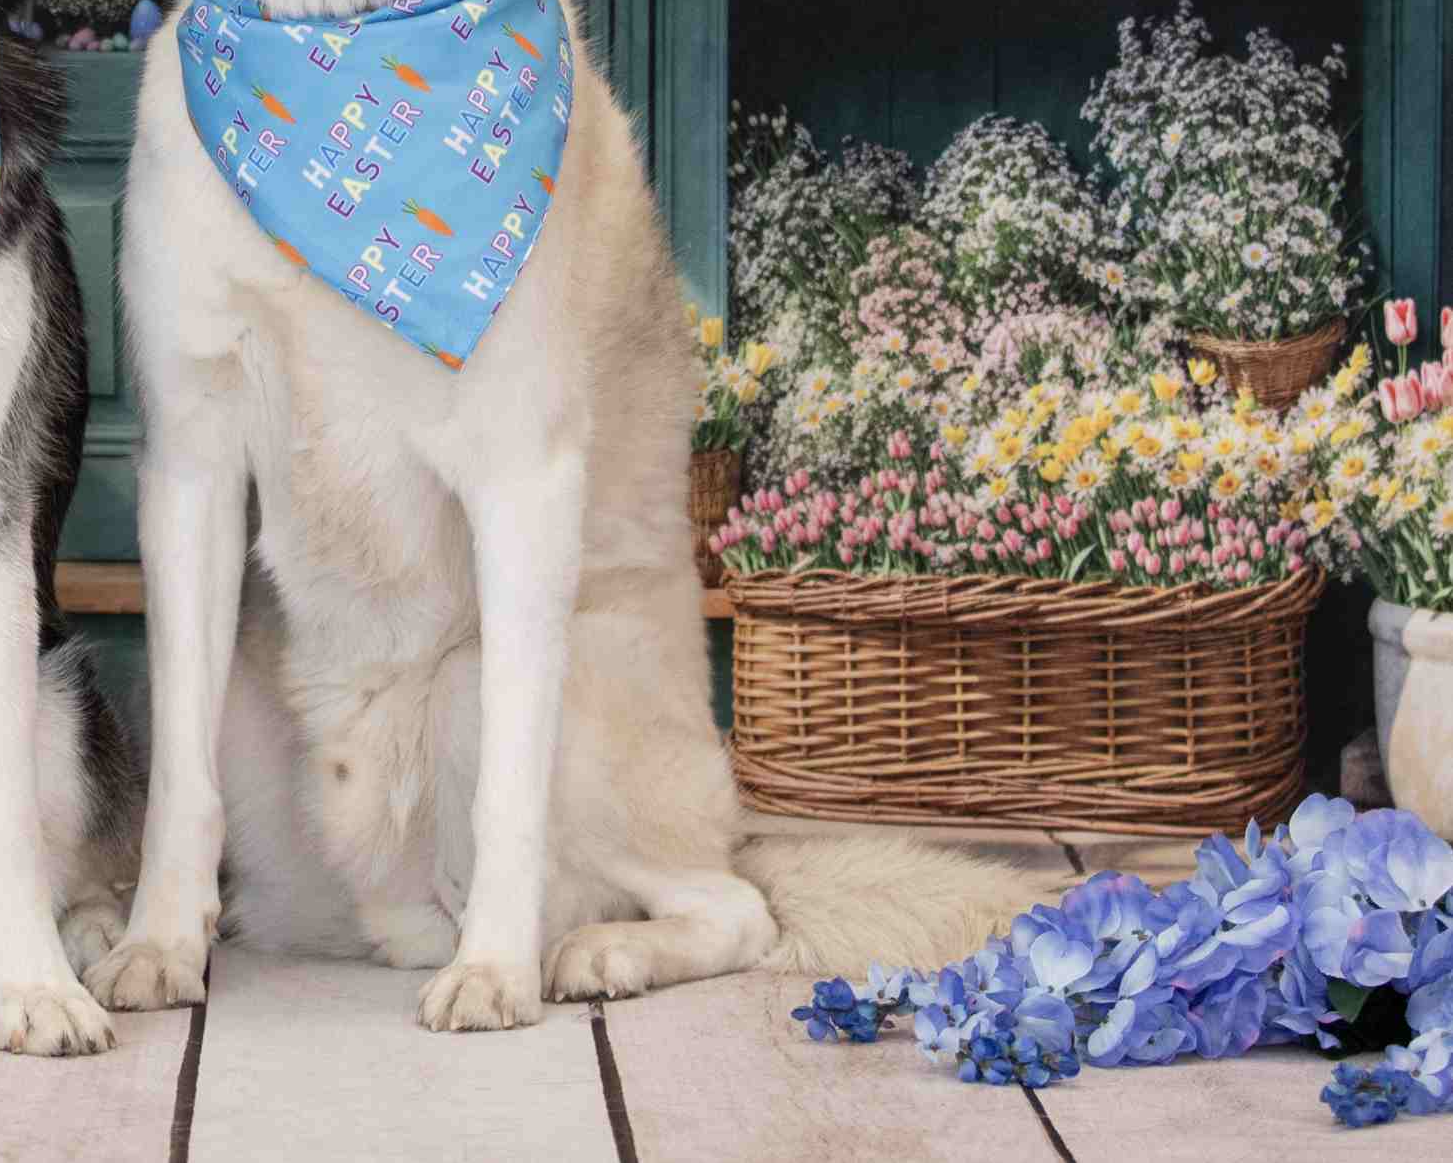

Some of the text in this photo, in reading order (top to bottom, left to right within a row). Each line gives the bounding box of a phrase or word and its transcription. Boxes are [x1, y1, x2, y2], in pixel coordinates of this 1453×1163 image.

[183, 4, 223, 66] HAP
[203, 4, 252, 97] EASTE
[308, 18, 362, 73] EAS
[216, 109, 251, 173] PPY
[302, 83, 380, 190] HAPPY
[443, 47, 511, 156] HAPPY
[469, 65, 539, 185] EASTER
[234, 127, 289, 207] STER
[325, 98, 424, 221] EASTER
[339, 221, 402, 308] APPY
[373, 241, 444, 325] STER
[461, 190, 536, 302] HAPPY
